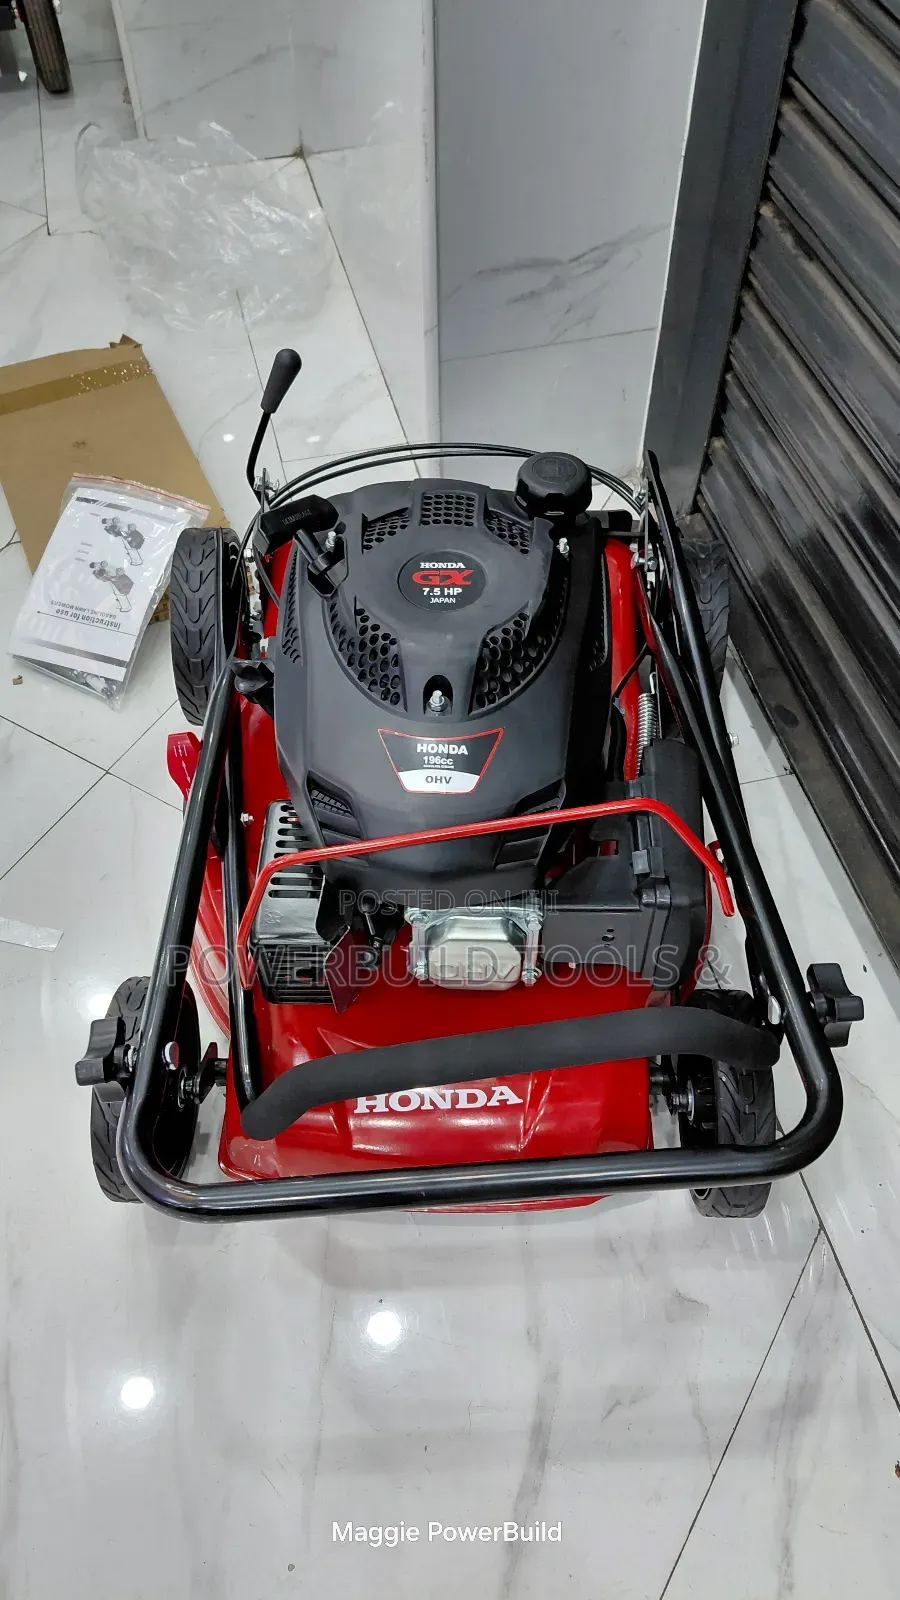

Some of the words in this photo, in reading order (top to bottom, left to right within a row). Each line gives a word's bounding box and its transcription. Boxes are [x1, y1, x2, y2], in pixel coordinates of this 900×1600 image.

[412, 569, 475, 586] GX
[422, 587, 441, 596] 7.5
[444, 587, 463, 596] HP
[55, 608, 69, 617] use
[69, 611, 81, 621] for
[81, 614, 121, 630] Instruction
[416, 743, 469, 755] HONDA
[423, 755, 453, 765] 196cc
[425, 775, 452, 785] OHV
[353, 1086, 523, 1114] HONDA
